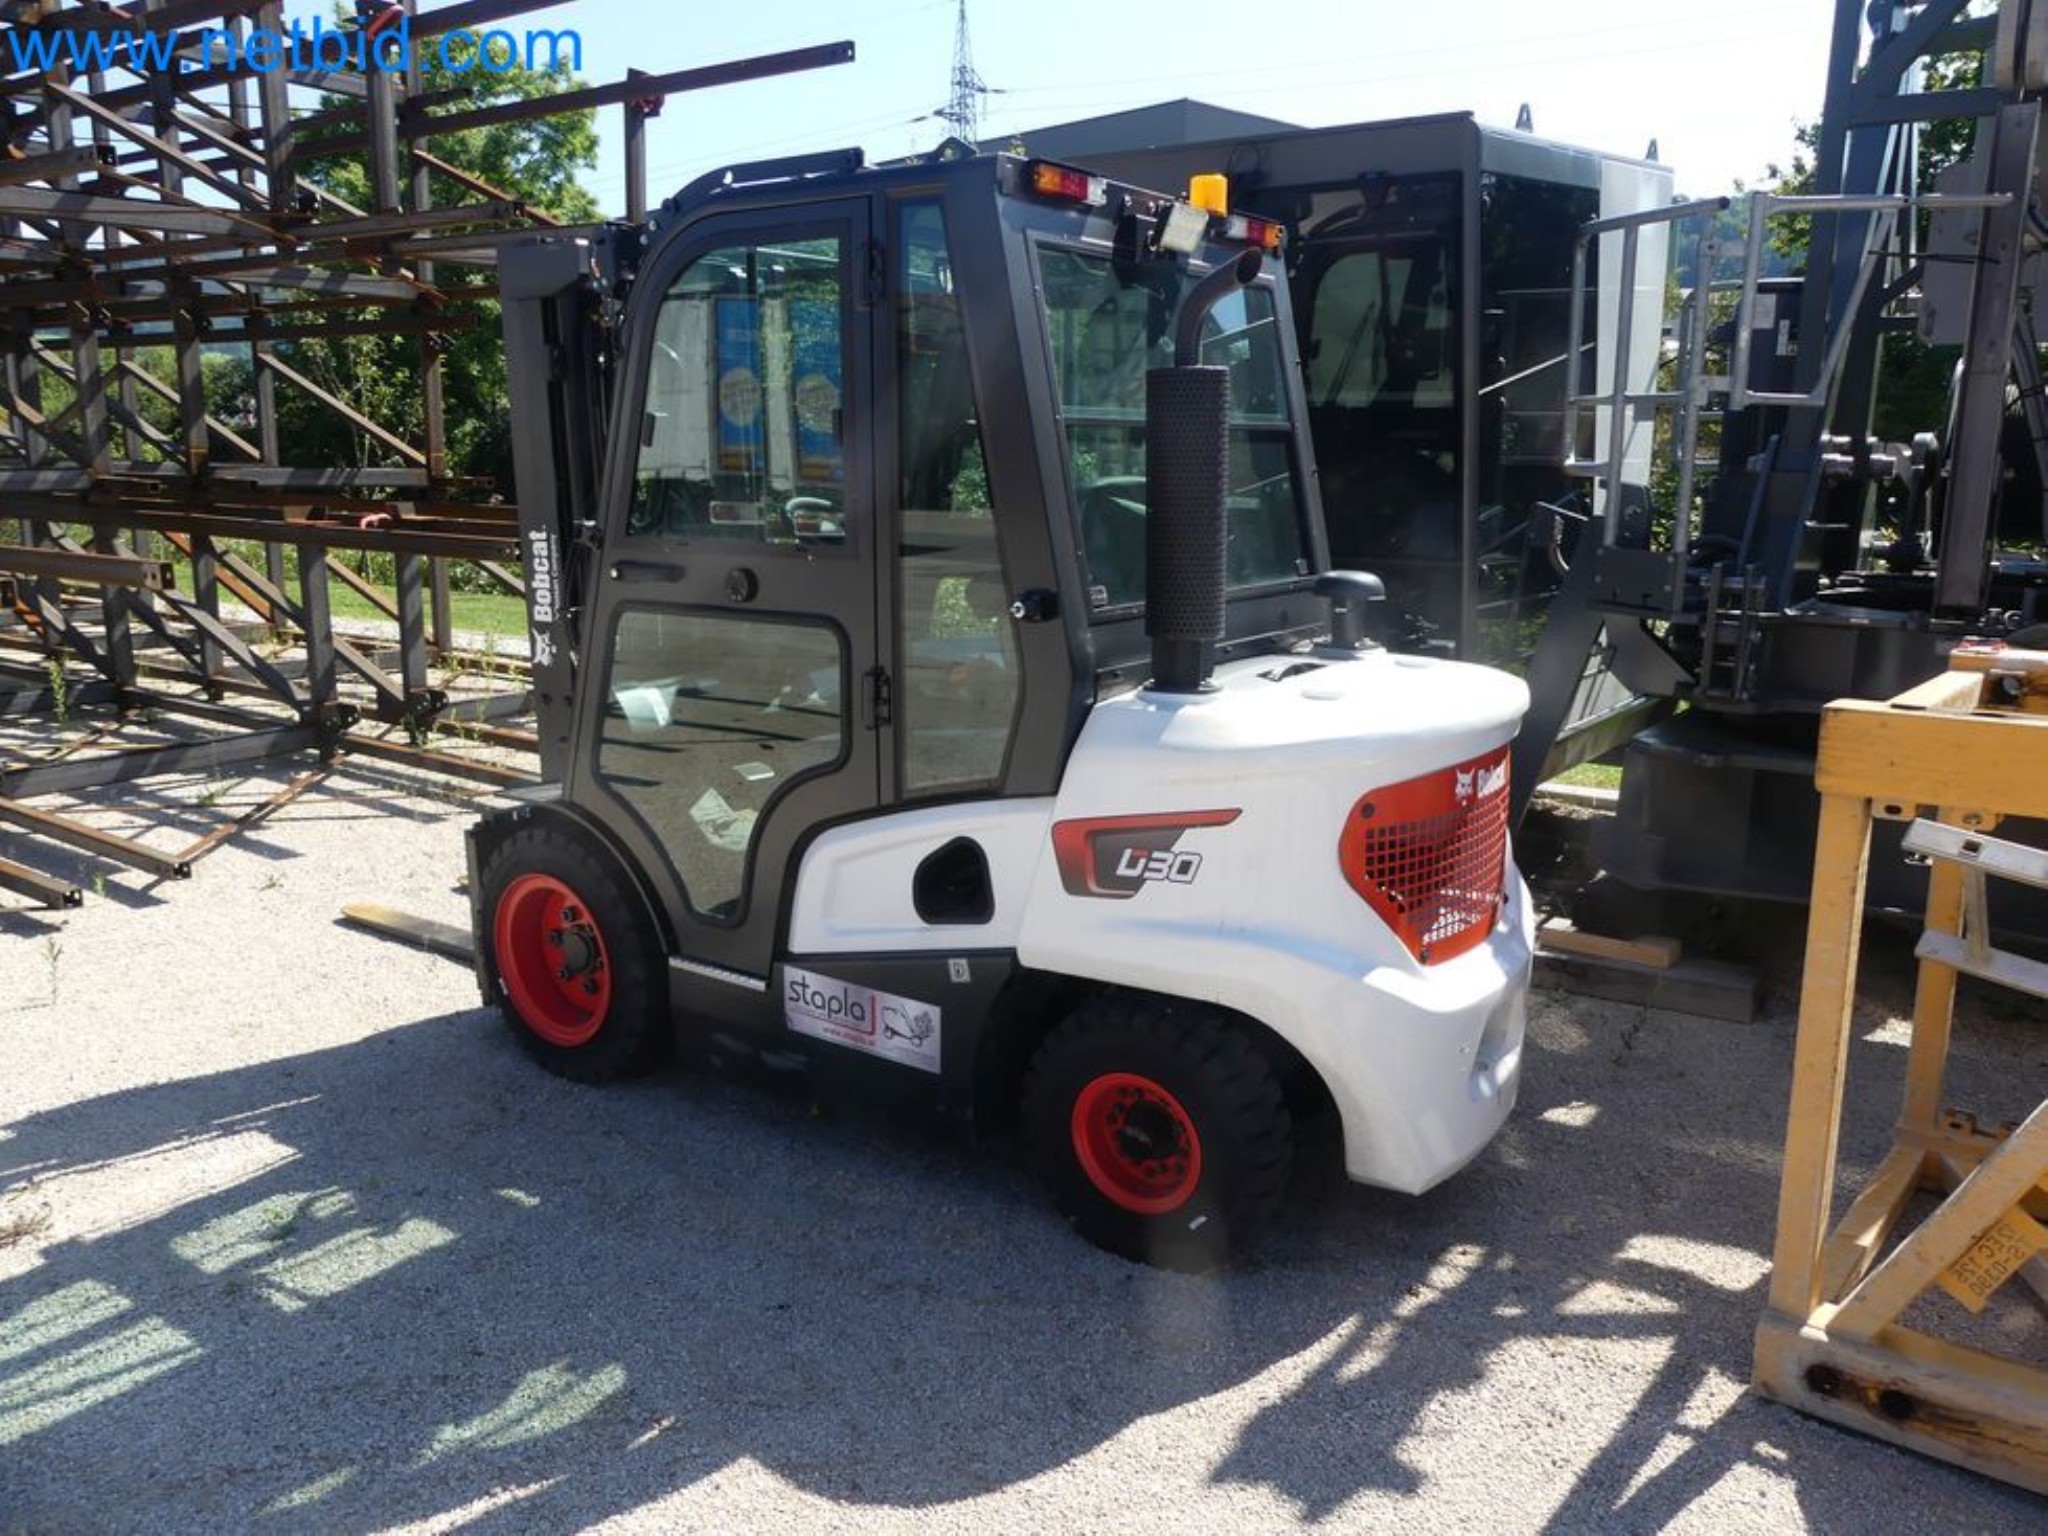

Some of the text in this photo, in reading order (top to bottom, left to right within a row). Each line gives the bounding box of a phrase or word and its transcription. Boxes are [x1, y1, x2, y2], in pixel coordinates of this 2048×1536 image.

[528, 530, 553, 622] Bobcat
[1115, 848, 1203, 884] D30
[788, 974, 867, 1022] stapla
